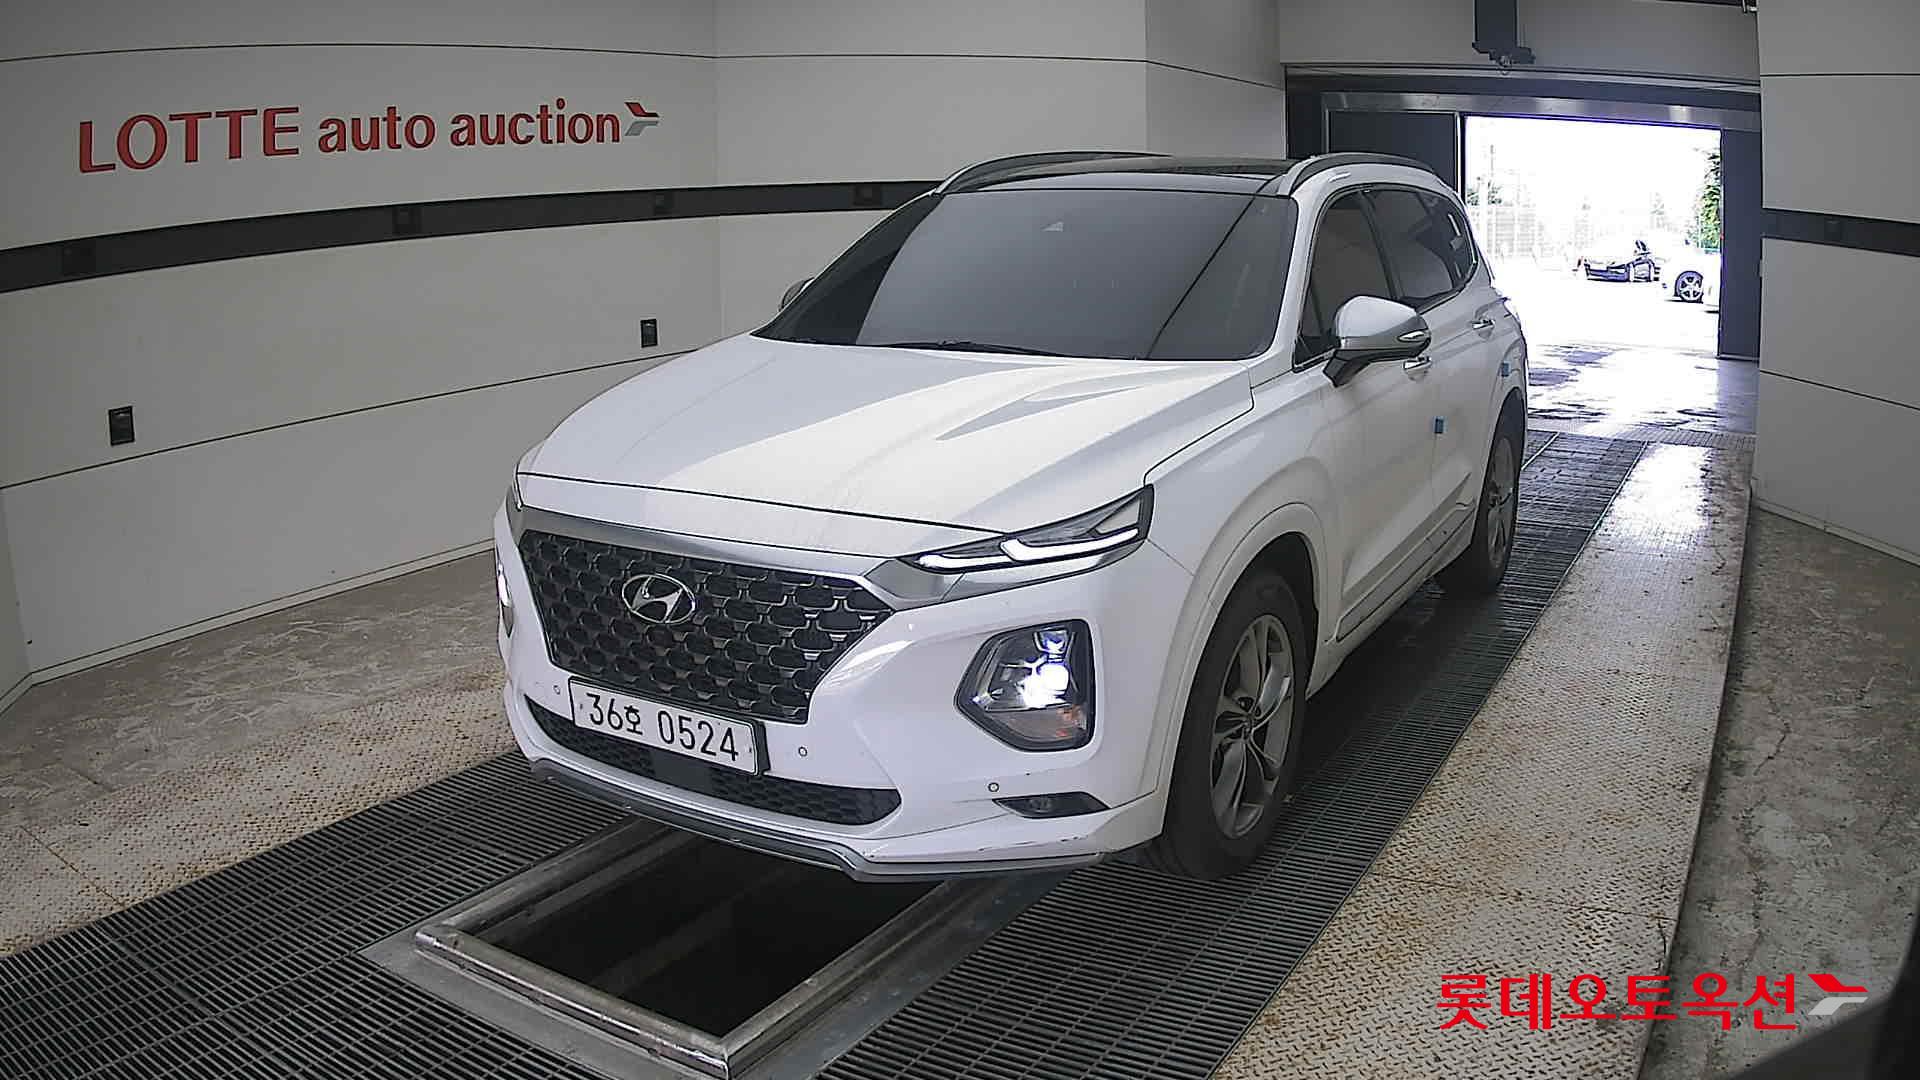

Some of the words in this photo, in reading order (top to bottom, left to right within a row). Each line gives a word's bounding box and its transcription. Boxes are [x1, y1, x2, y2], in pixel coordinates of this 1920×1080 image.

[78, 106, 300, 174] LOTTE
[317, 106, 437, 154] auto
[449, 97, 622, 147] auction
[586, 692, 643, 736] 36호
[657, 709, 739, 762] 0524
